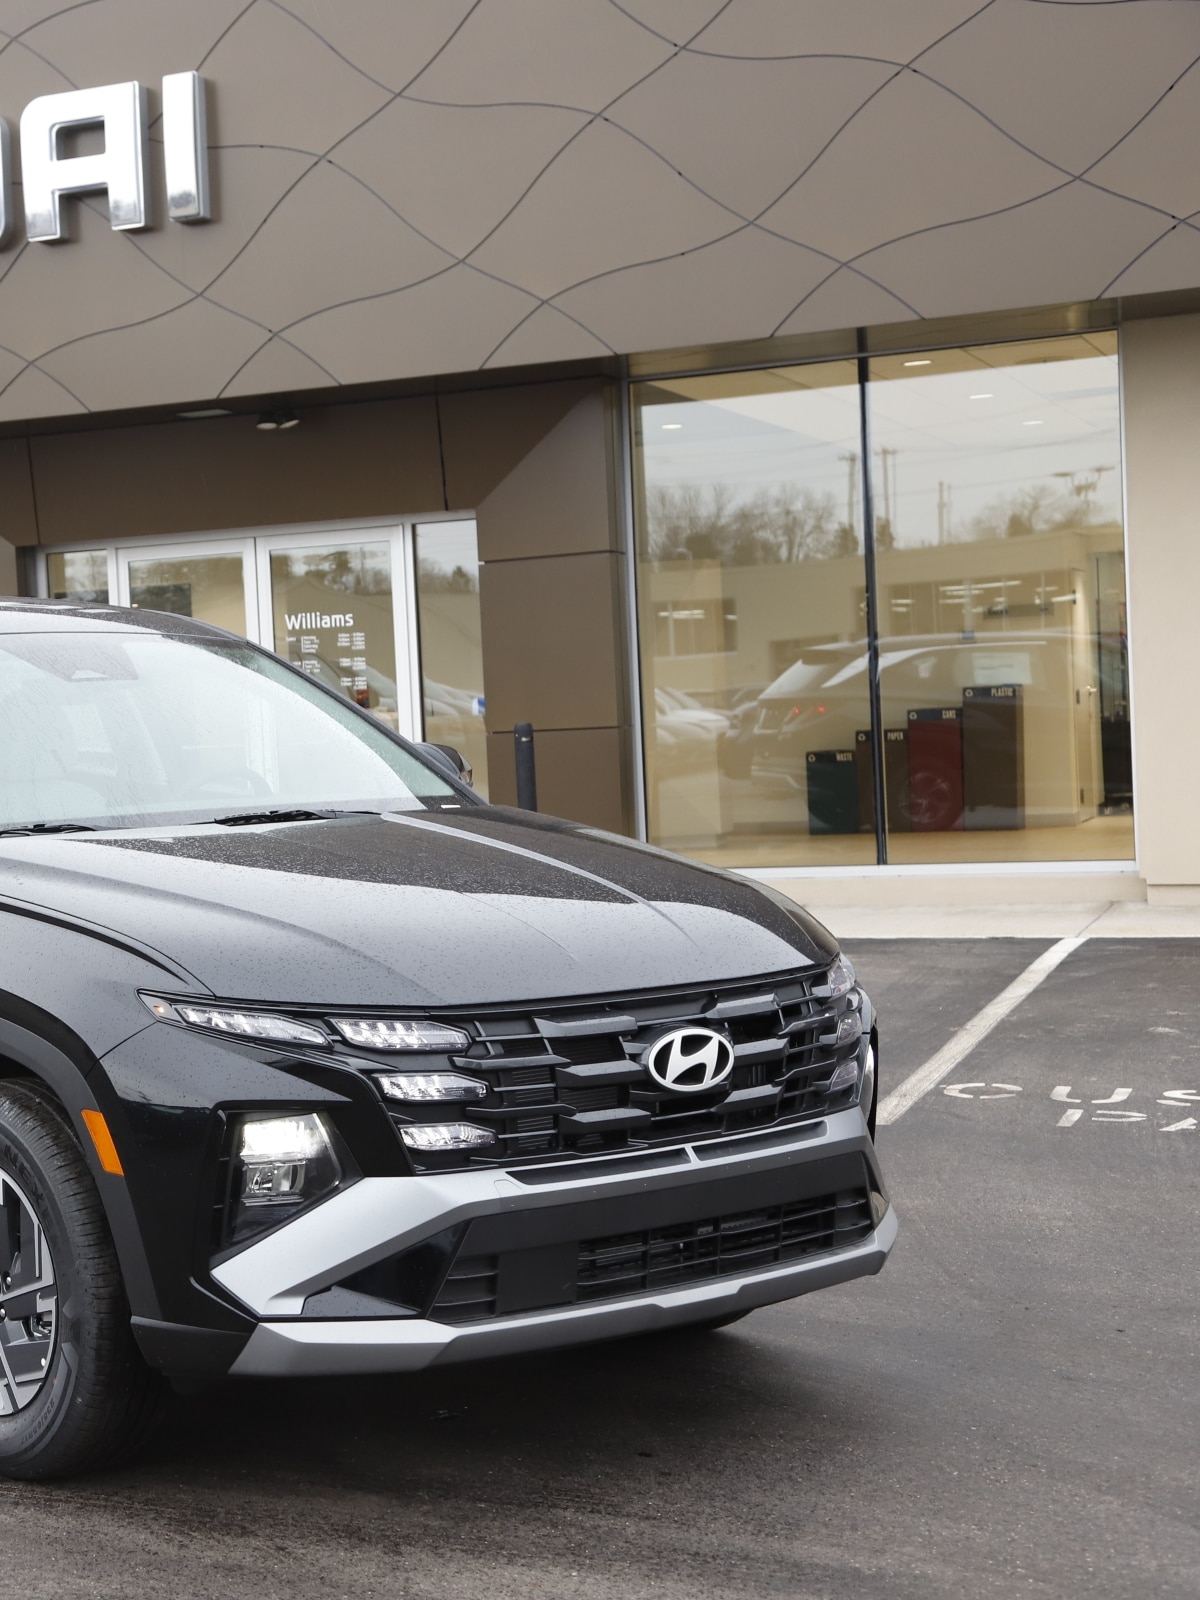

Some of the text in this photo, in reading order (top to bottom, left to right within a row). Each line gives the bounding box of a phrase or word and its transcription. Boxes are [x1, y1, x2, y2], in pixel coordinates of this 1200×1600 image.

[284, 611, 354, 631] Williams
[990, 687, 1014, 697] PLASTIC
[886, 731, 904, 741] PAPER
